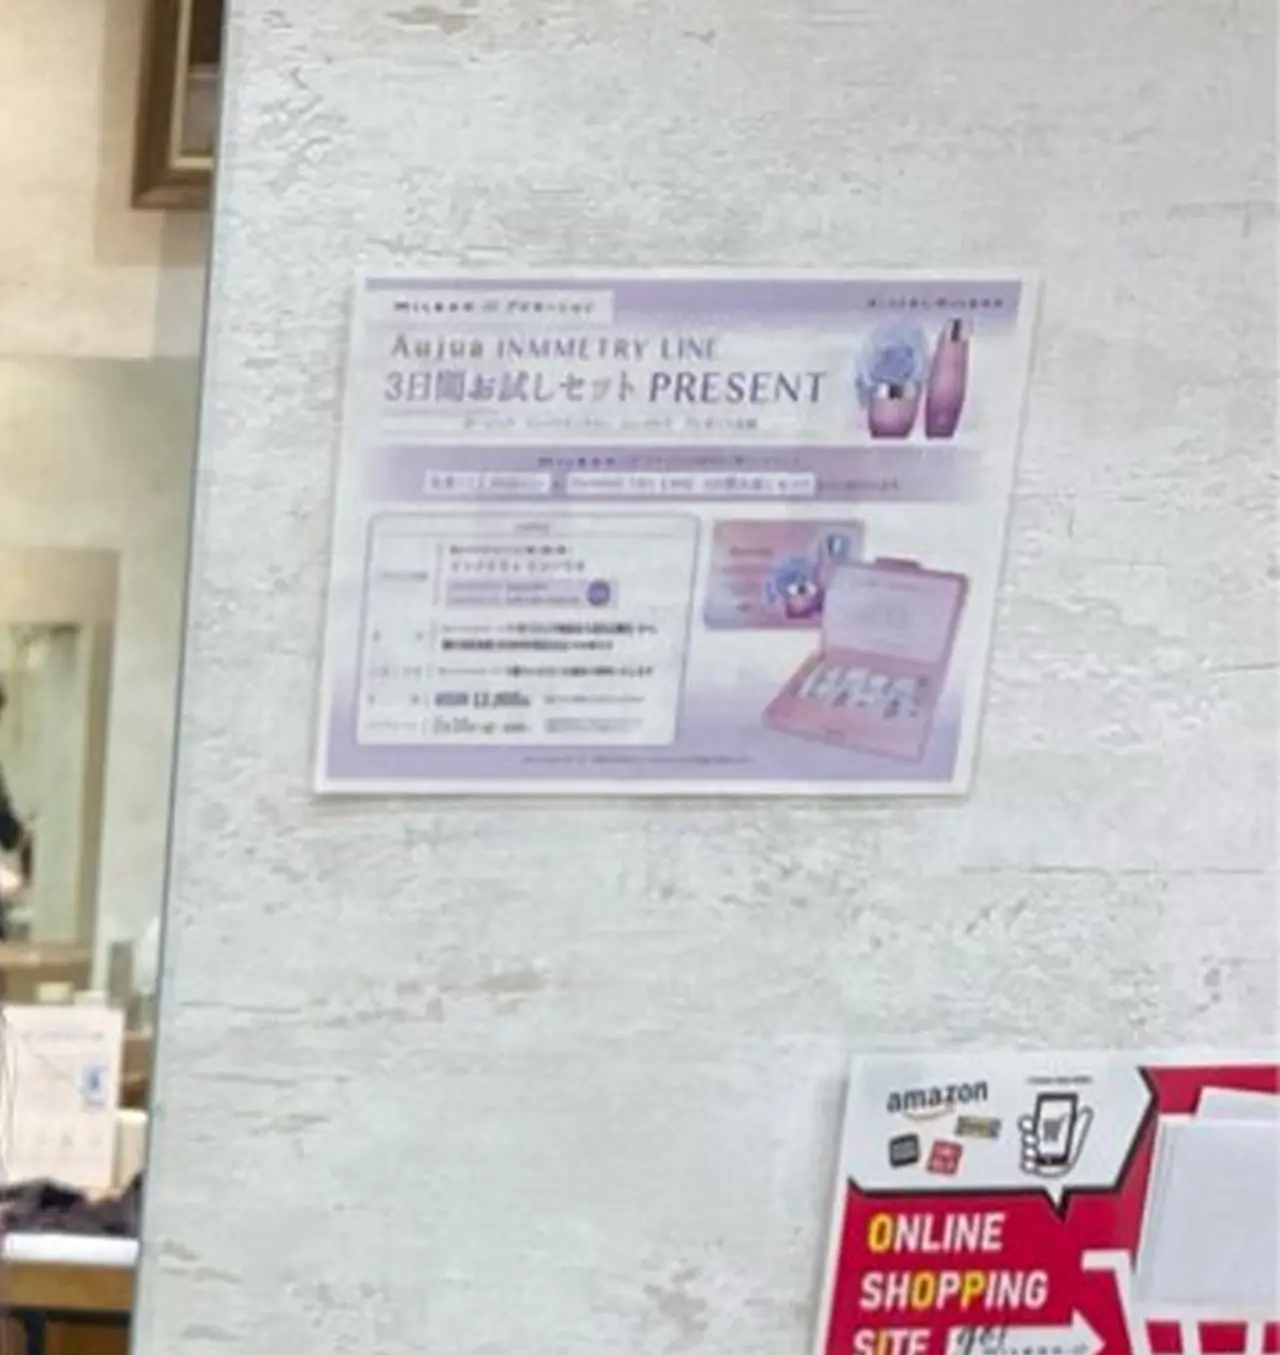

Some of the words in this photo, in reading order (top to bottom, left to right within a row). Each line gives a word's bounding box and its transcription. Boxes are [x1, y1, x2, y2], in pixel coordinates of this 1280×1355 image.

[647, 371, 828, 404] PRESENT
[886, 1079, 989, 1114] amazon
[867, 1211, 1007, 1254] ONLINE
[858, 1268, 1049, 1312] SHOPPING
